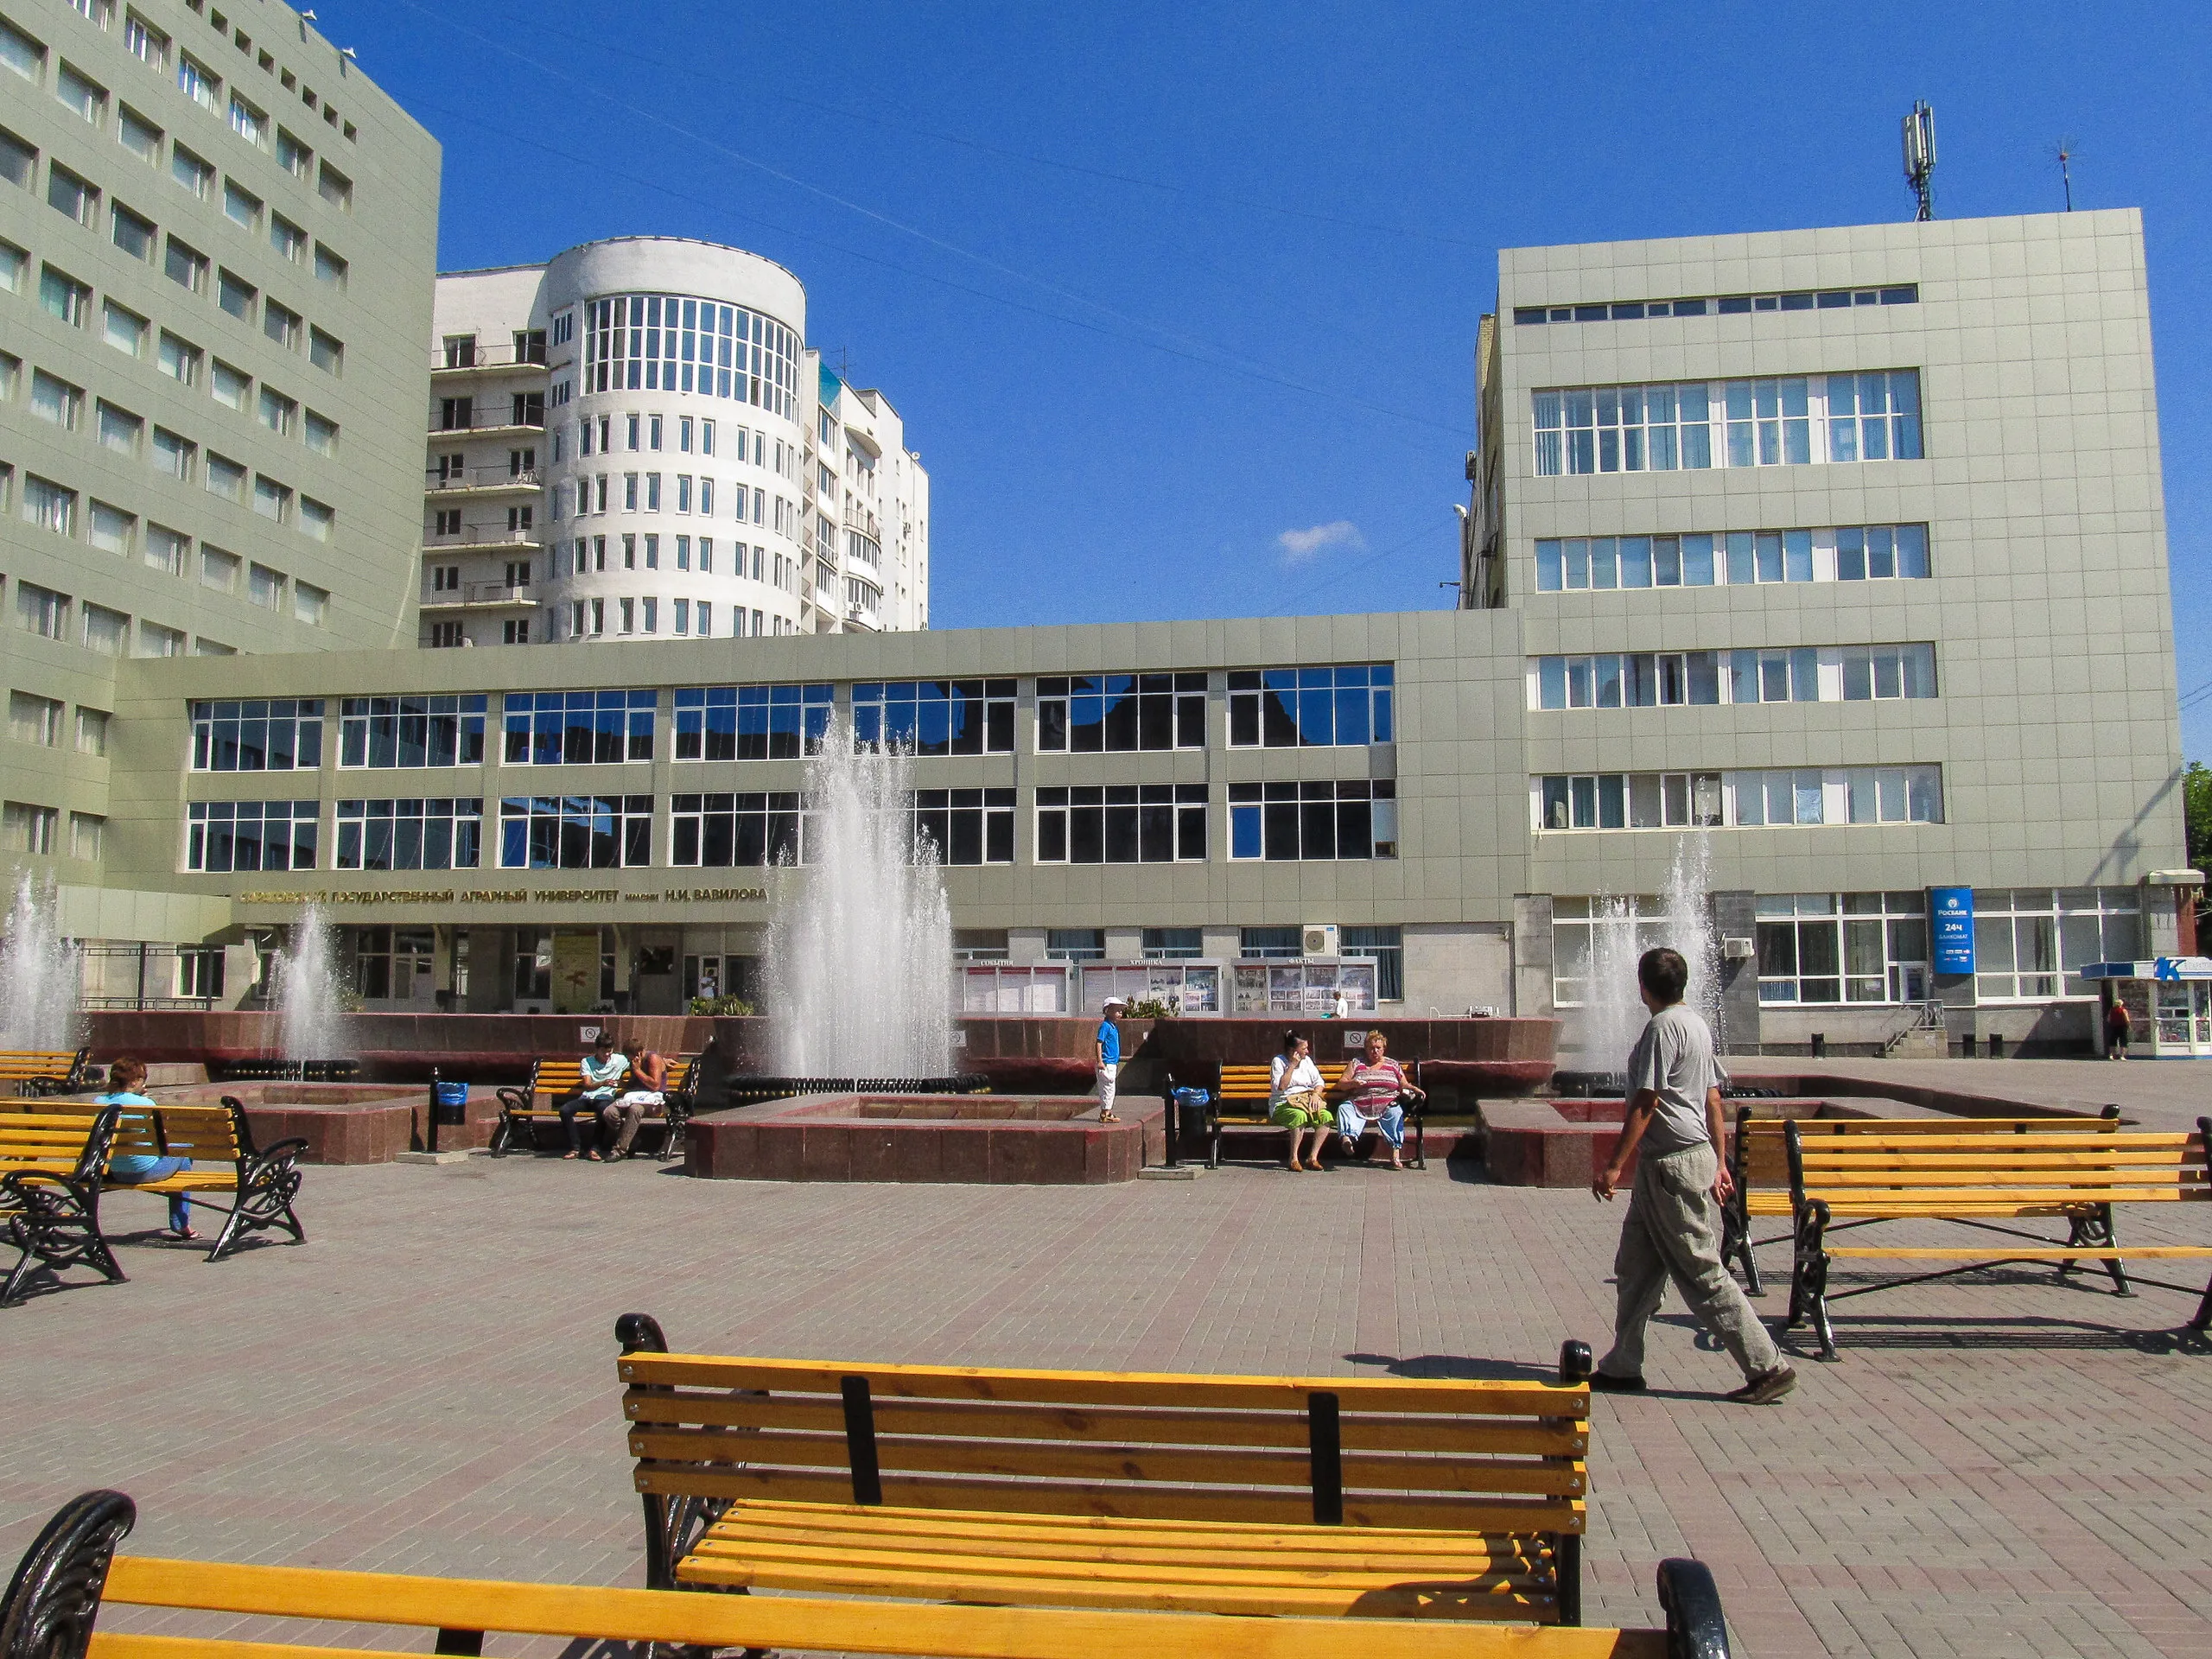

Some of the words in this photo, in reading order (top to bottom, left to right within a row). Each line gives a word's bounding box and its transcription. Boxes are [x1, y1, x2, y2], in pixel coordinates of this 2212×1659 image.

[332, 888, 454, 904] ГОСУДАРСТВЕННЫЙ
[461, 888, 528, 903] АГРАРНЫЙ
[534, 889, 620, 903] УНИВЕРСИТЕТ
[664, 888, 691, 901] Н.И.
[694, 887, 767, 901] ВАВИЛОВА
